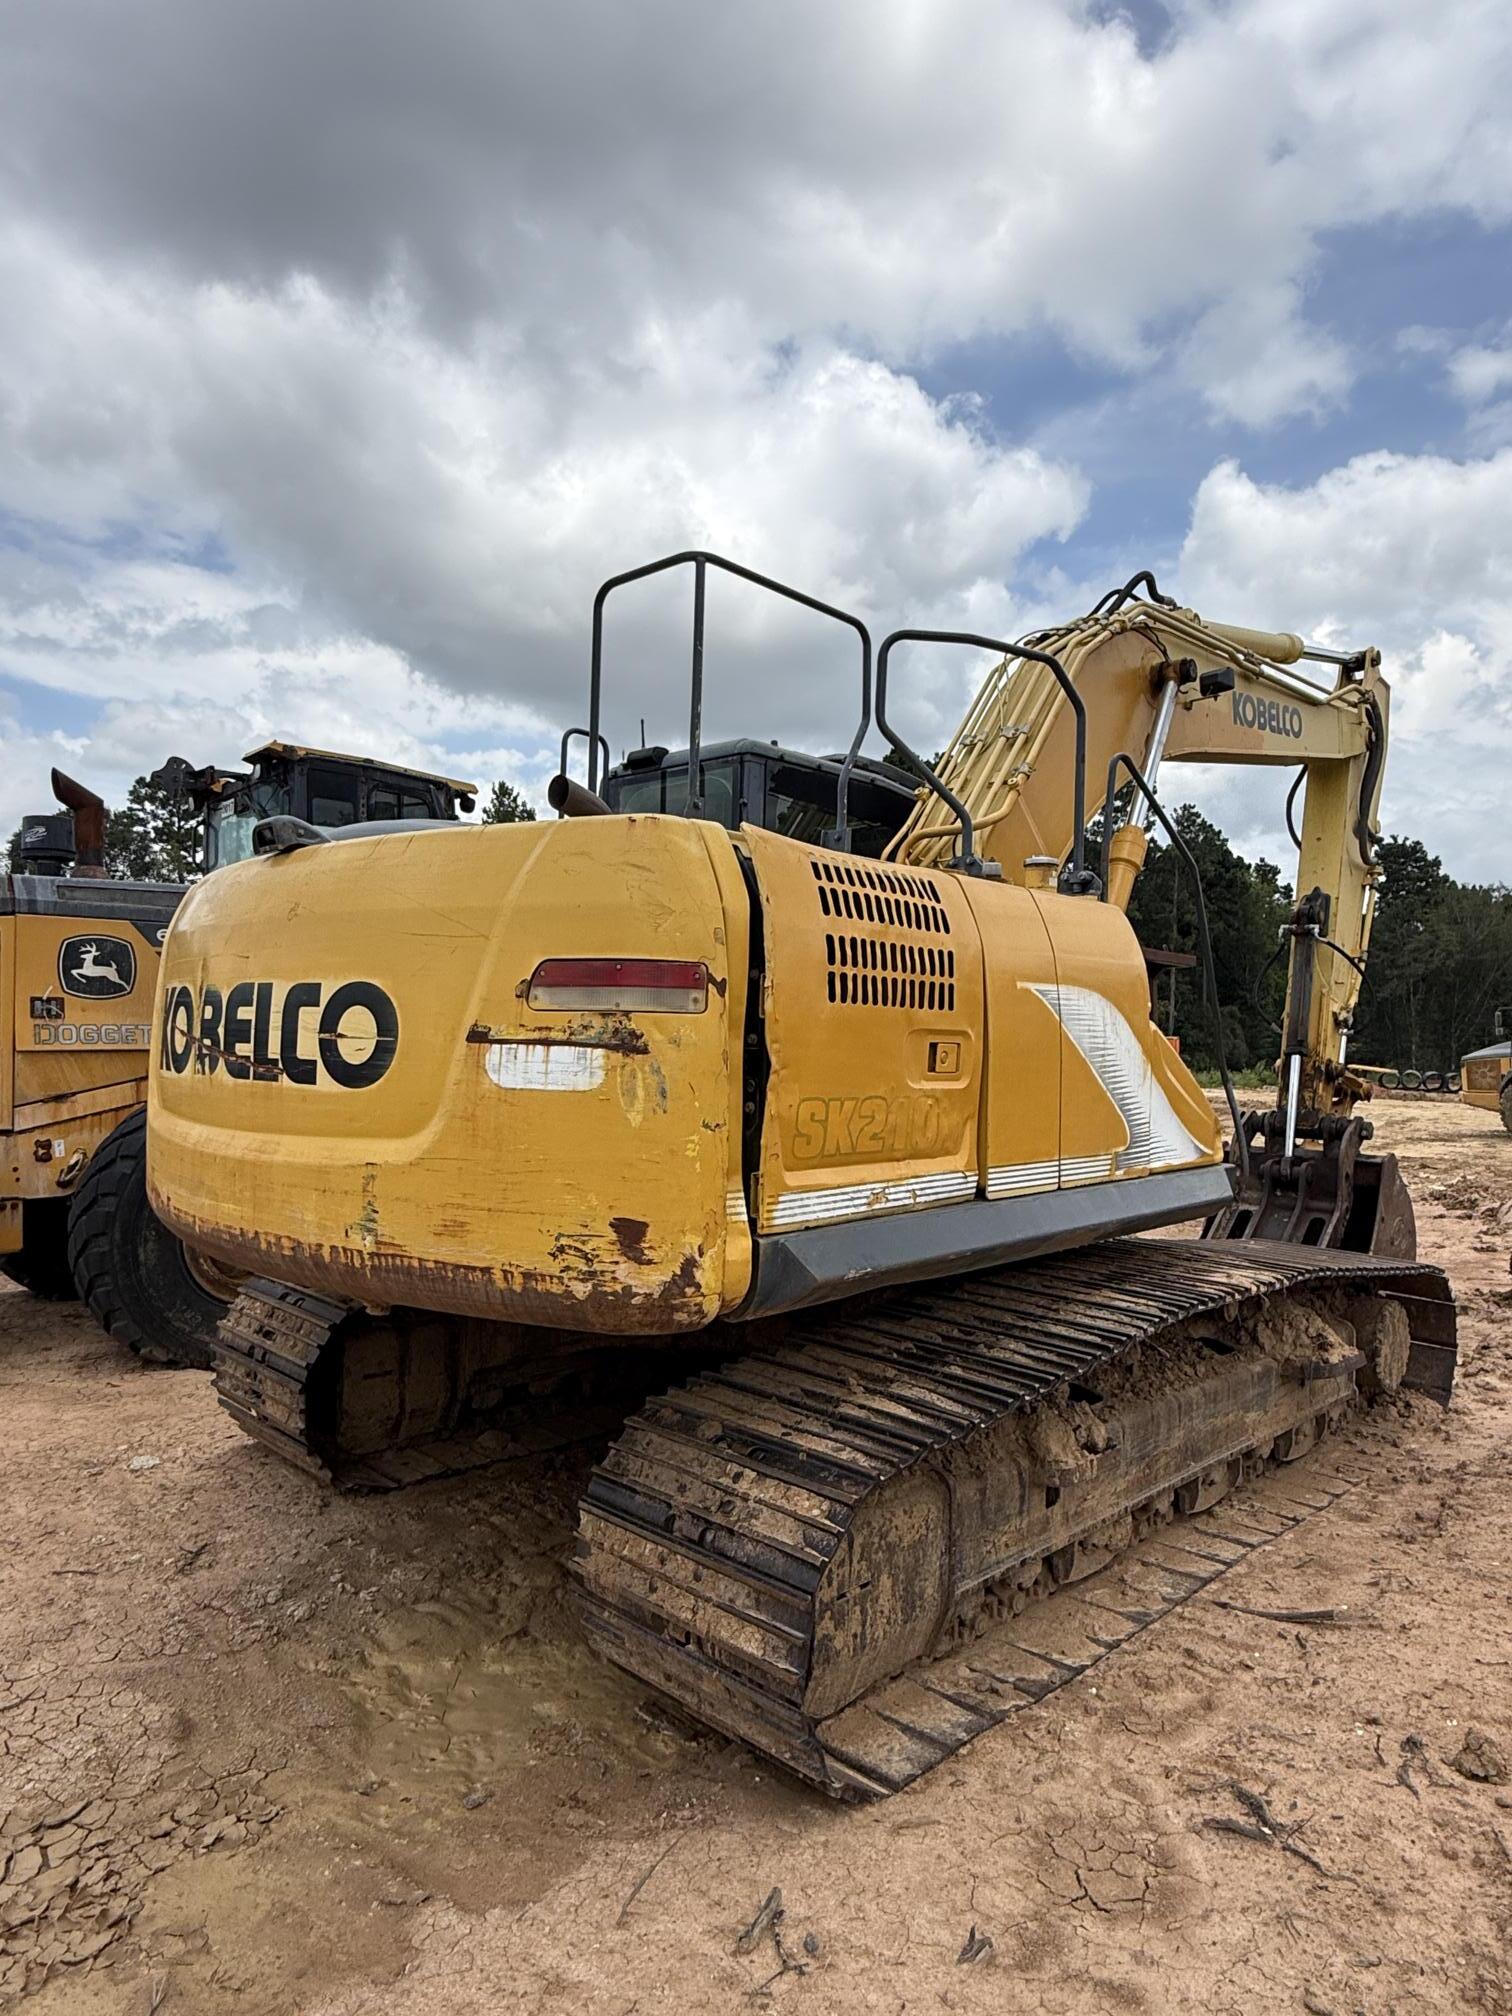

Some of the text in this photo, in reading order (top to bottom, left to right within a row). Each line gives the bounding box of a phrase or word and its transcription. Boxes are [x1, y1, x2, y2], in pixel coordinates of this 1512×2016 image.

[1232, 691, 1302, 739] KOBELCO
[160, 981, 399, 1089] KOBELCO
[793, 1095, 940, 1159] SK210
